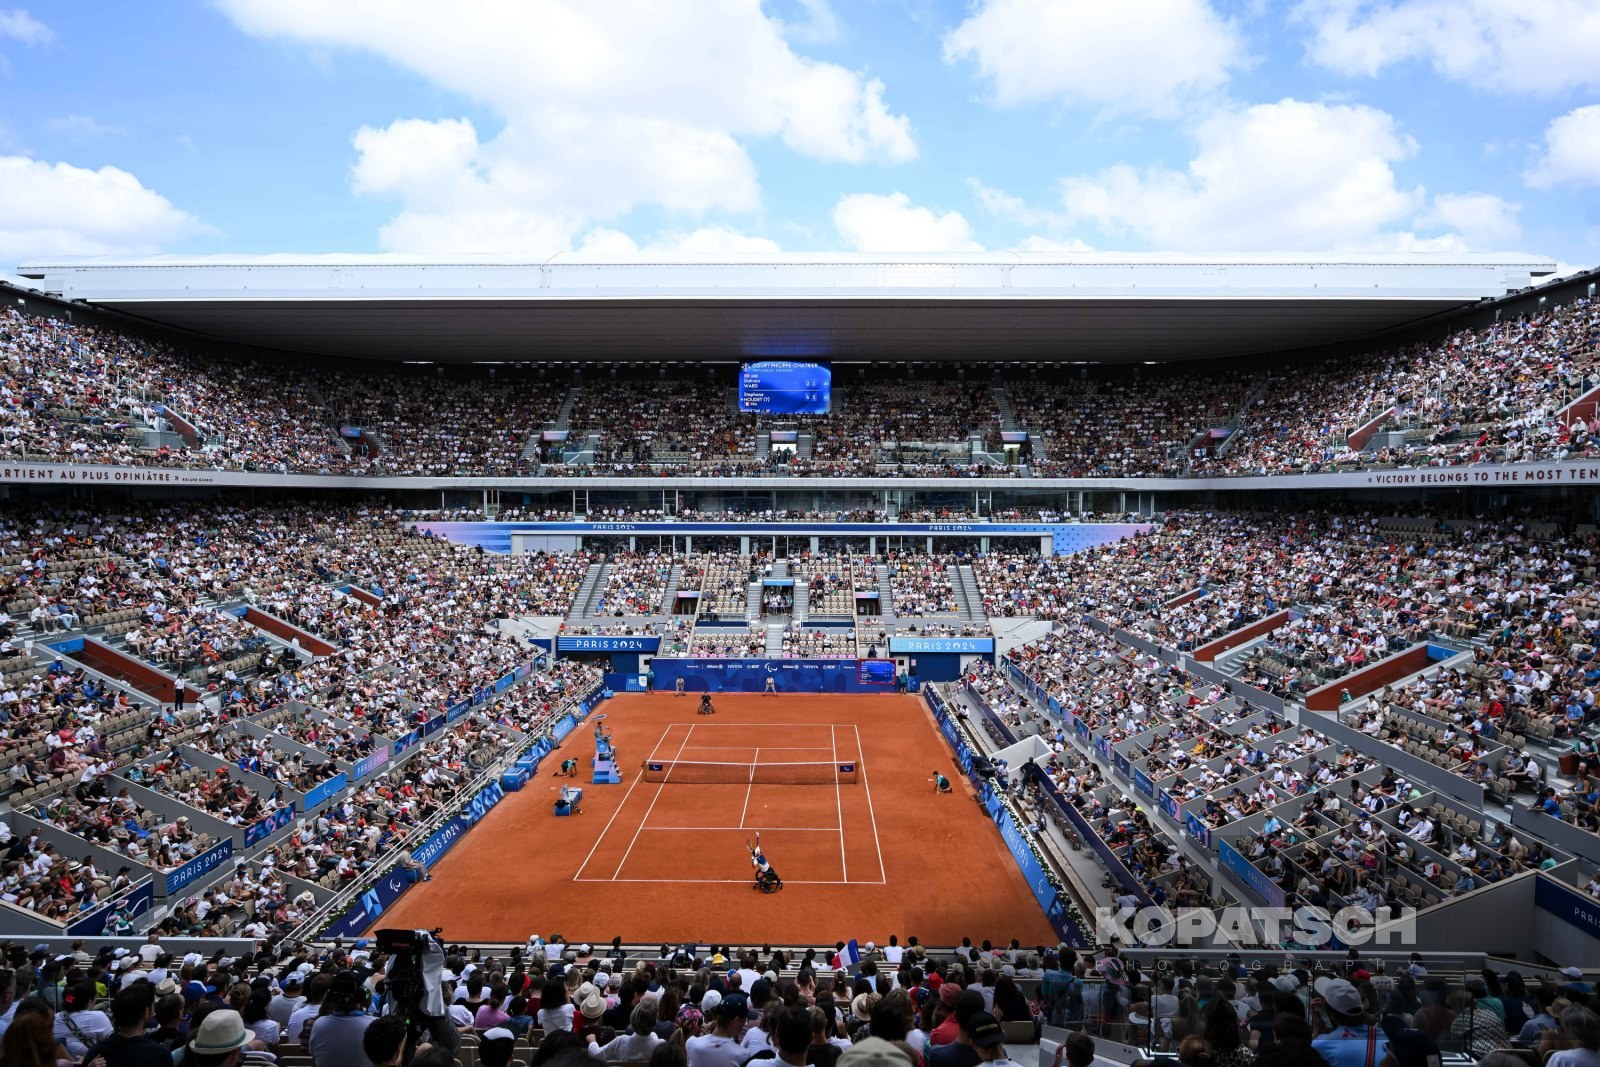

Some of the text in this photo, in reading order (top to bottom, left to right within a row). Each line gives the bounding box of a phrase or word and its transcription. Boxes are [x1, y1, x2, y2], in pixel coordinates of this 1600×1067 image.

[61, 471, 75, 479] AU
[82, 472, 109, 480] PLUS
[115, 471, 170, 481] OPINIÂTRE
[1376, 475, 1415, 483] VICTORY
[1421, 473, 1468, 482] BELONGS
[1474, 472, 1489, 481] TO
[1494, 471, 1518, 480] THE
[1525, 469, 1562, 480] MOST
[576, 640, 642, 649] PARIS 2024
[908, 642, 976, 650] PARIS 2024
[421, 823, 459, 863] PARIS 2024
[173, 846, 228, 886] PARIS 2024
